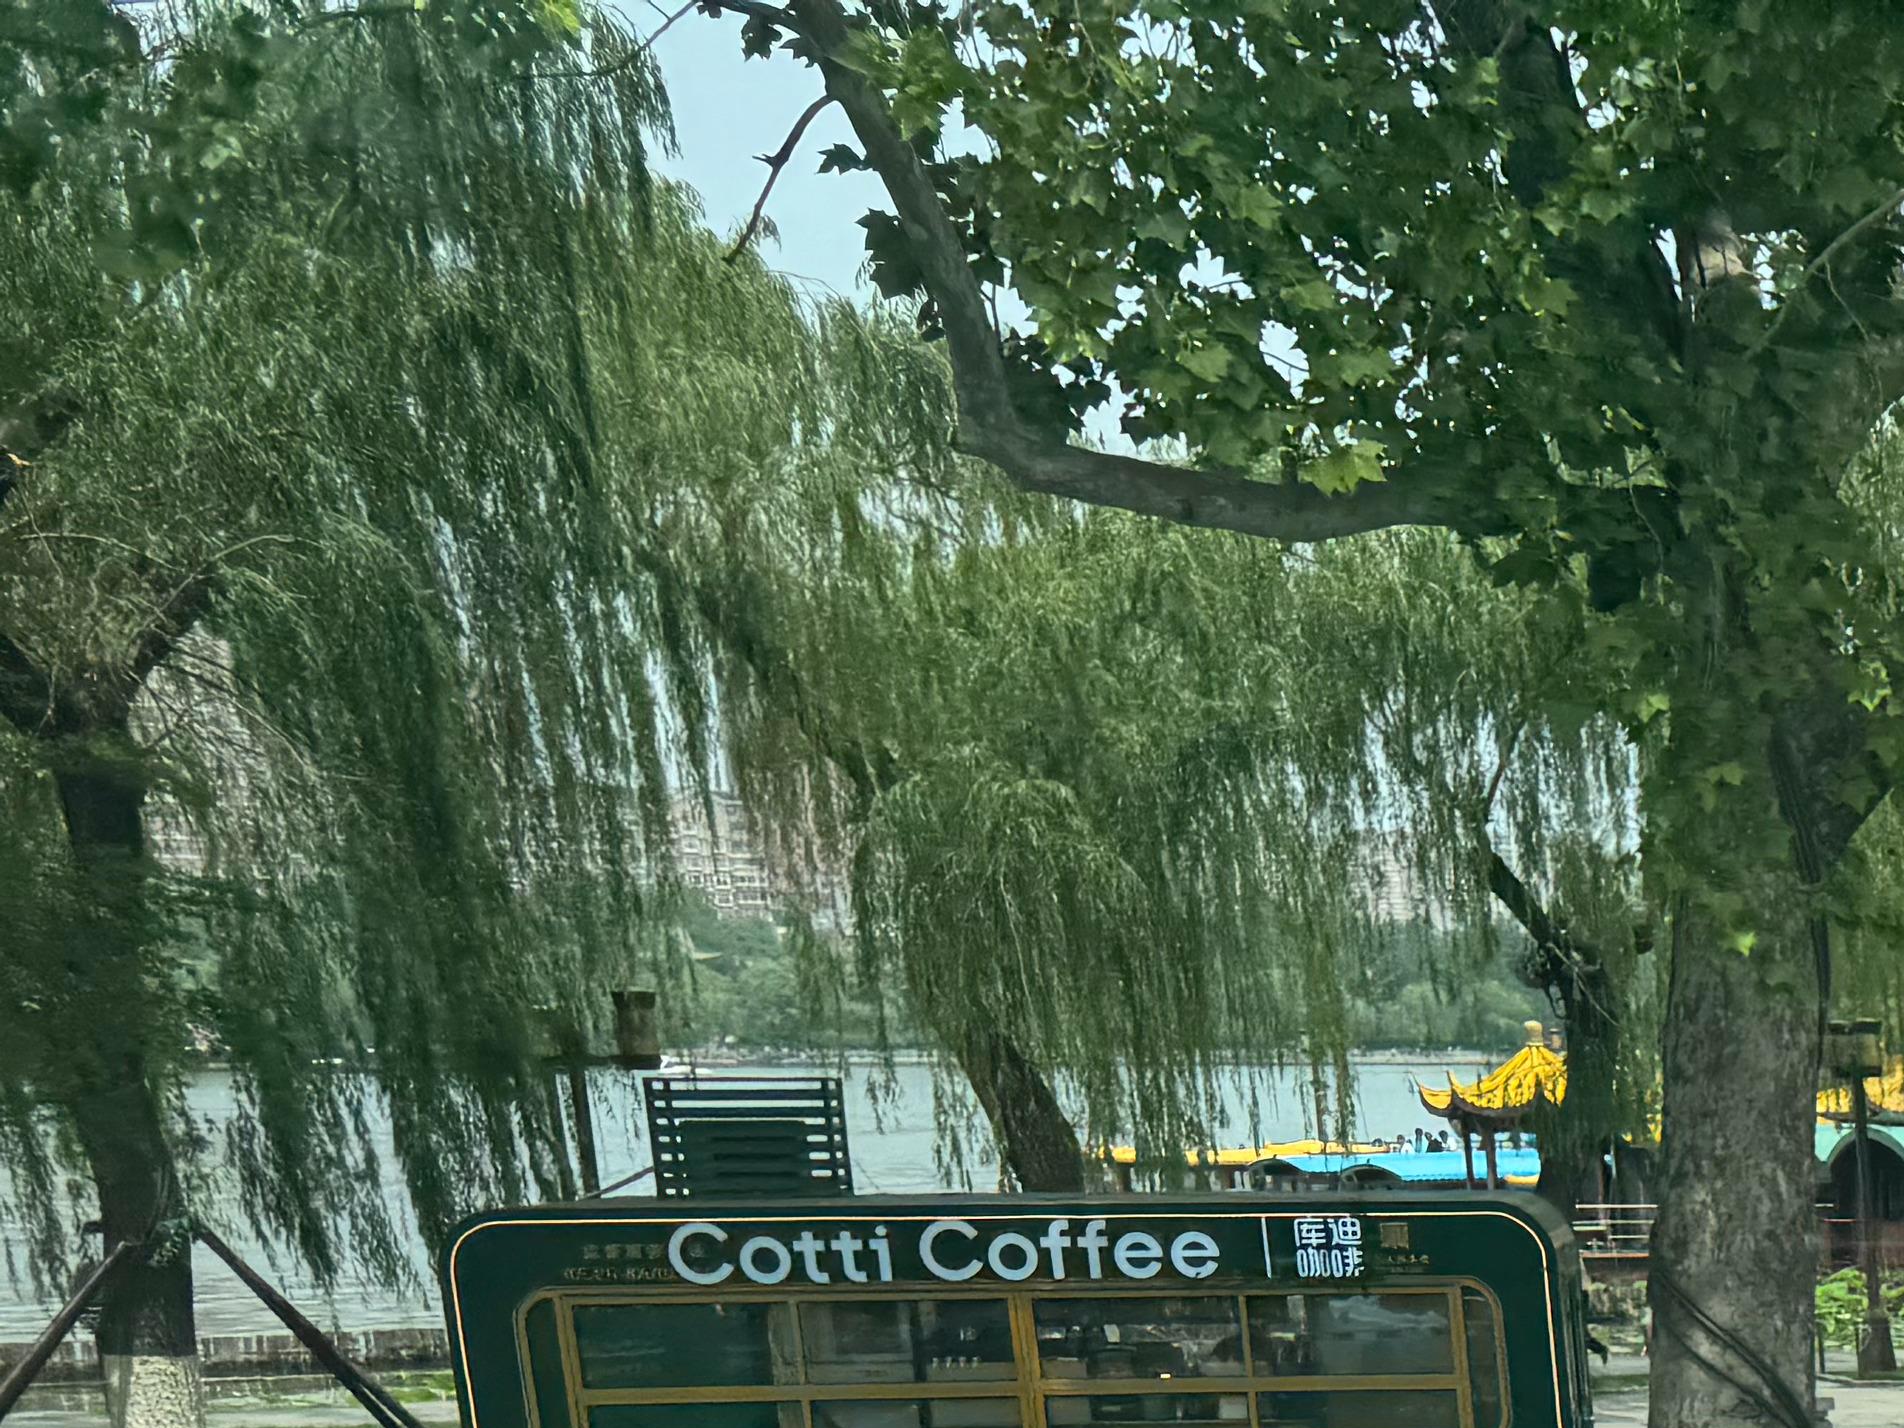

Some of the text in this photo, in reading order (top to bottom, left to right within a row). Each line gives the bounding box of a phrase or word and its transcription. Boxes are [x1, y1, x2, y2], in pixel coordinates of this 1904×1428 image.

[1293, 1215, 1363, 1247] 库迪
[668, 1219, 1220, 1285] Cotti Coffee
[1296, 1246, 1365, 1278] 咖啡
